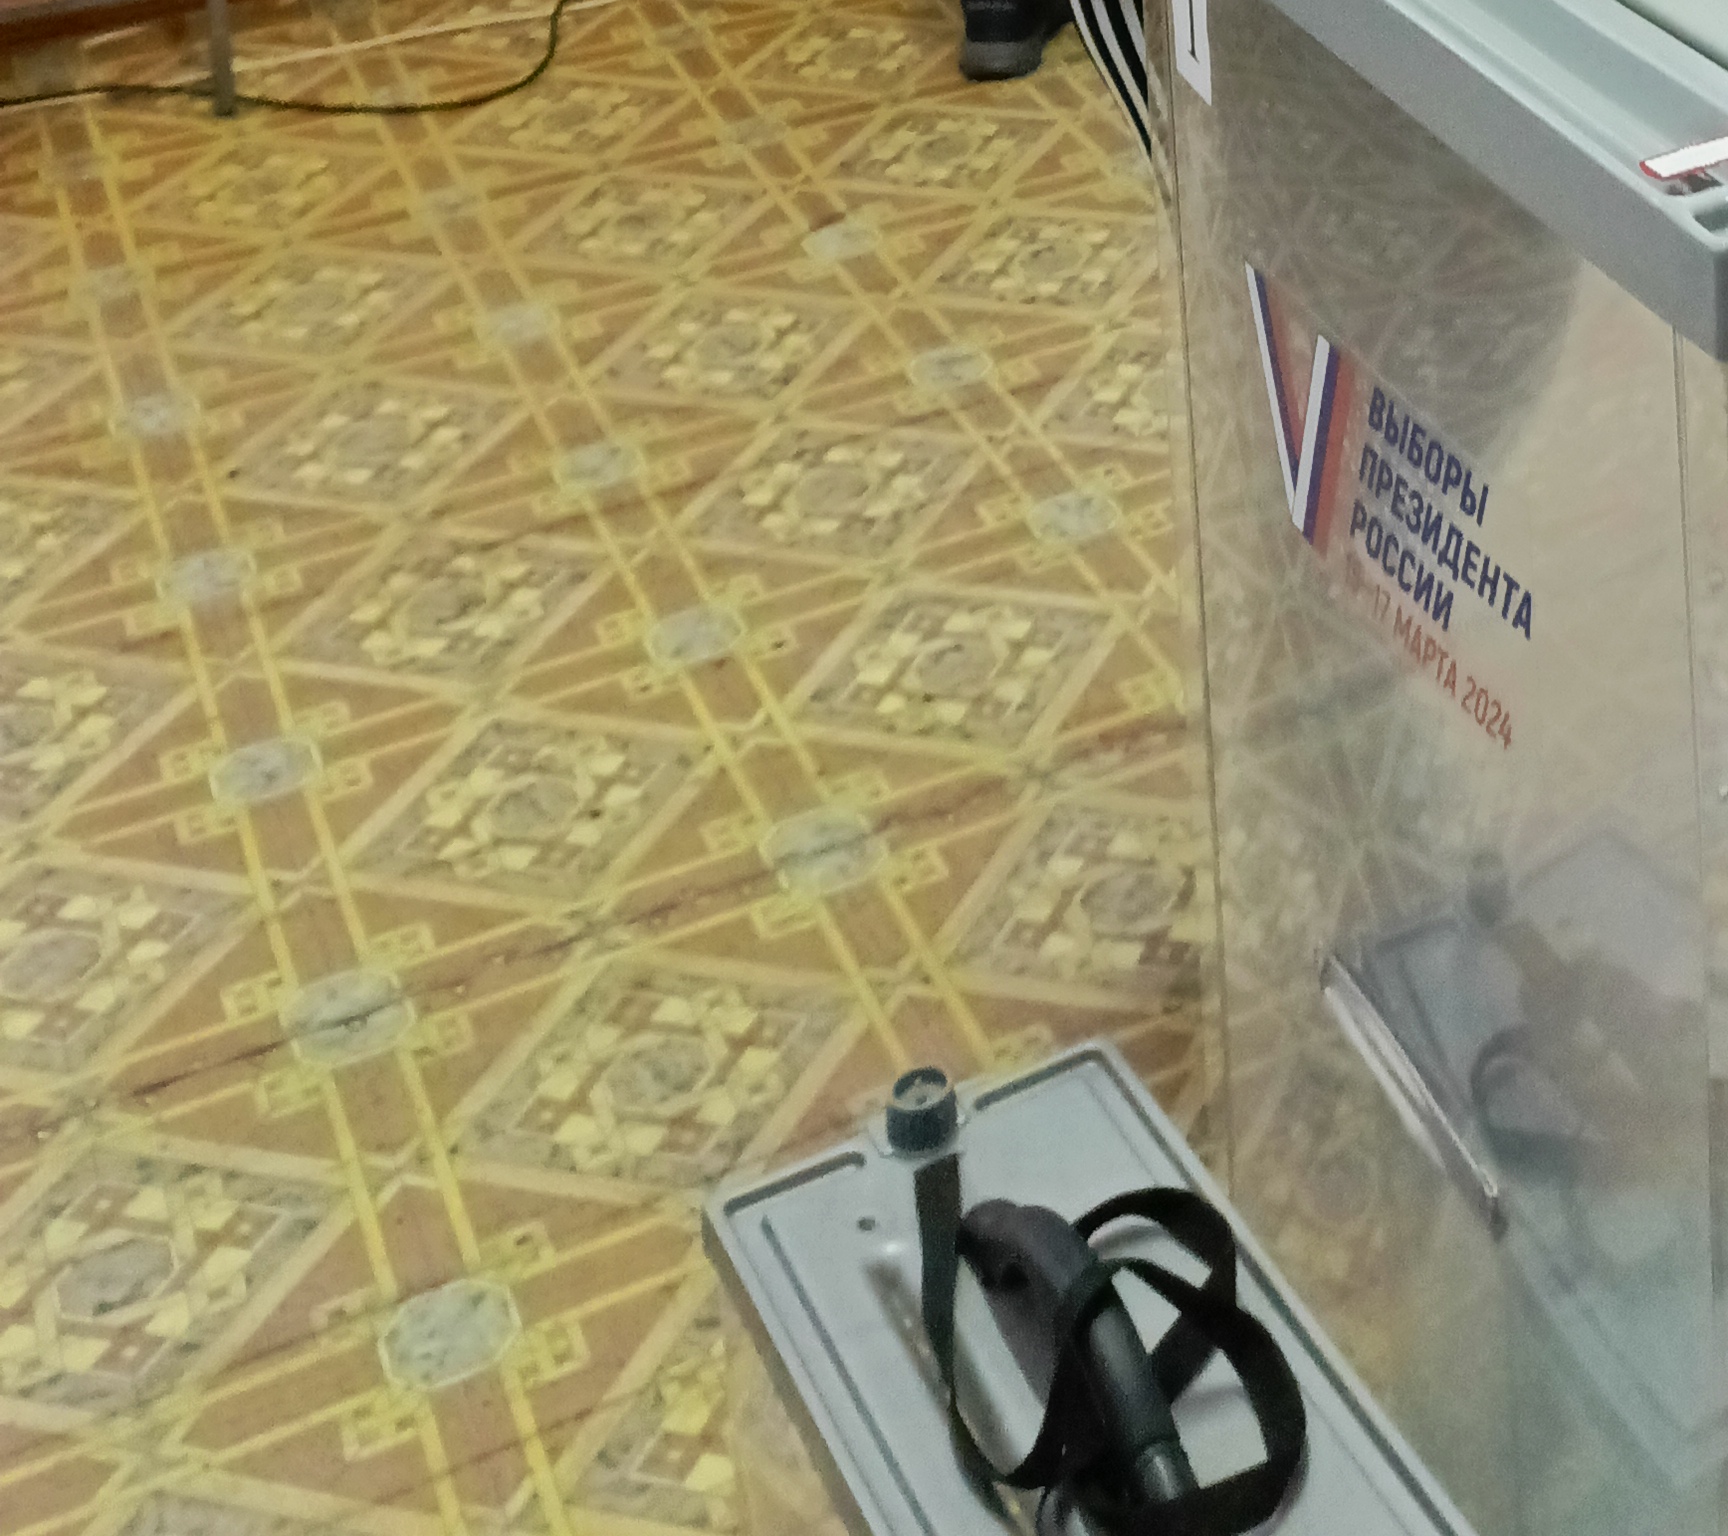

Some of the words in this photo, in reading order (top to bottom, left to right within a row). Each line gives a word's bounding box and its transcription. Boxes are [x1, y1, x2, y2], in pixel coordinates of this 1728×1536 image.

[1368, 386, 1489, 526] ВЫБОРЫ
[1350, 498, 1454, 632] РОССИИ
[1358, 443, 1534, 641] ПРЕЗИДЕНТА
[1393, 604, 1457, 699] МАРТА
[1461, 675, 1512, 750] 2024
